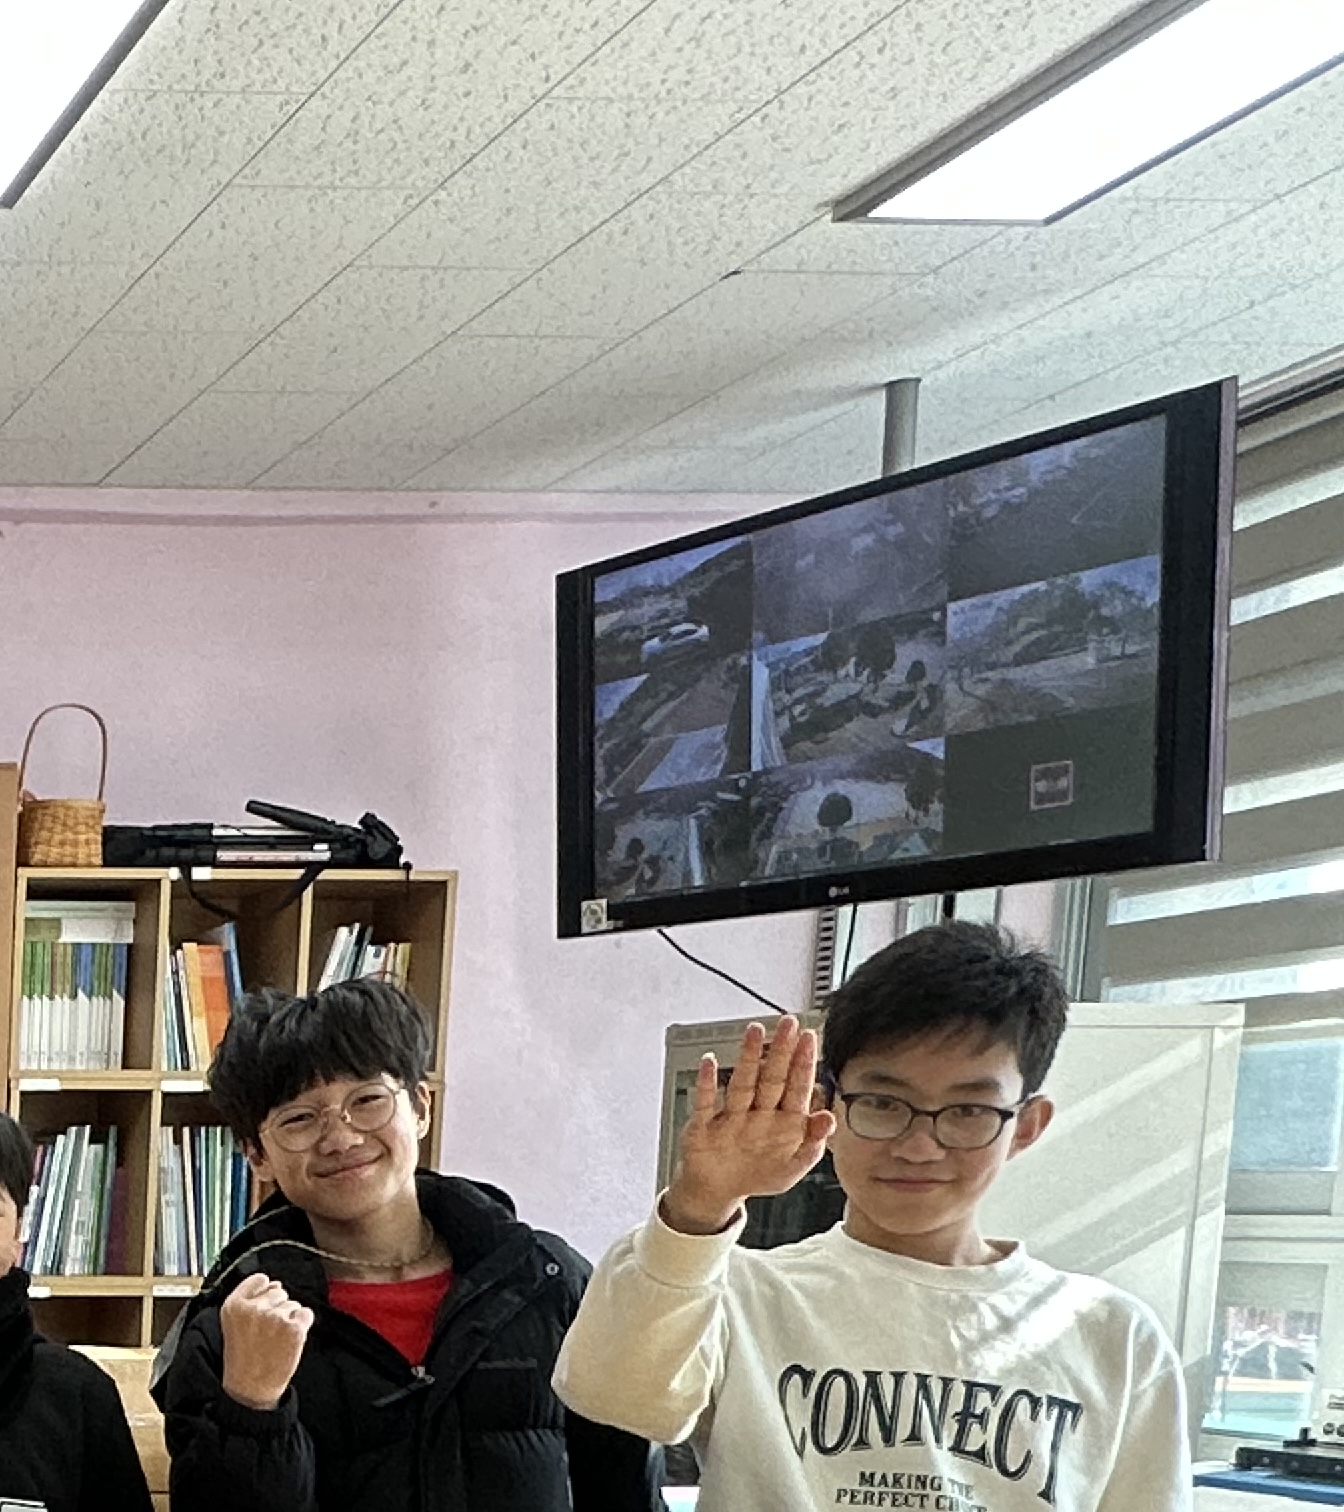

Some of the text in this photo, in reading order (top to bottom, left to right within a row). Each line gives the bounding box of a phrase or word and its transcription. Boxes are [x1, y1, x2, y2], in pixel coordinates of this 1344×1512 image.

[778, 1363, 1083, 1507] CONNECT
[858, 1470, 944, 1492] MAKING
[834, 1488, 930, 1508] PERFECT
